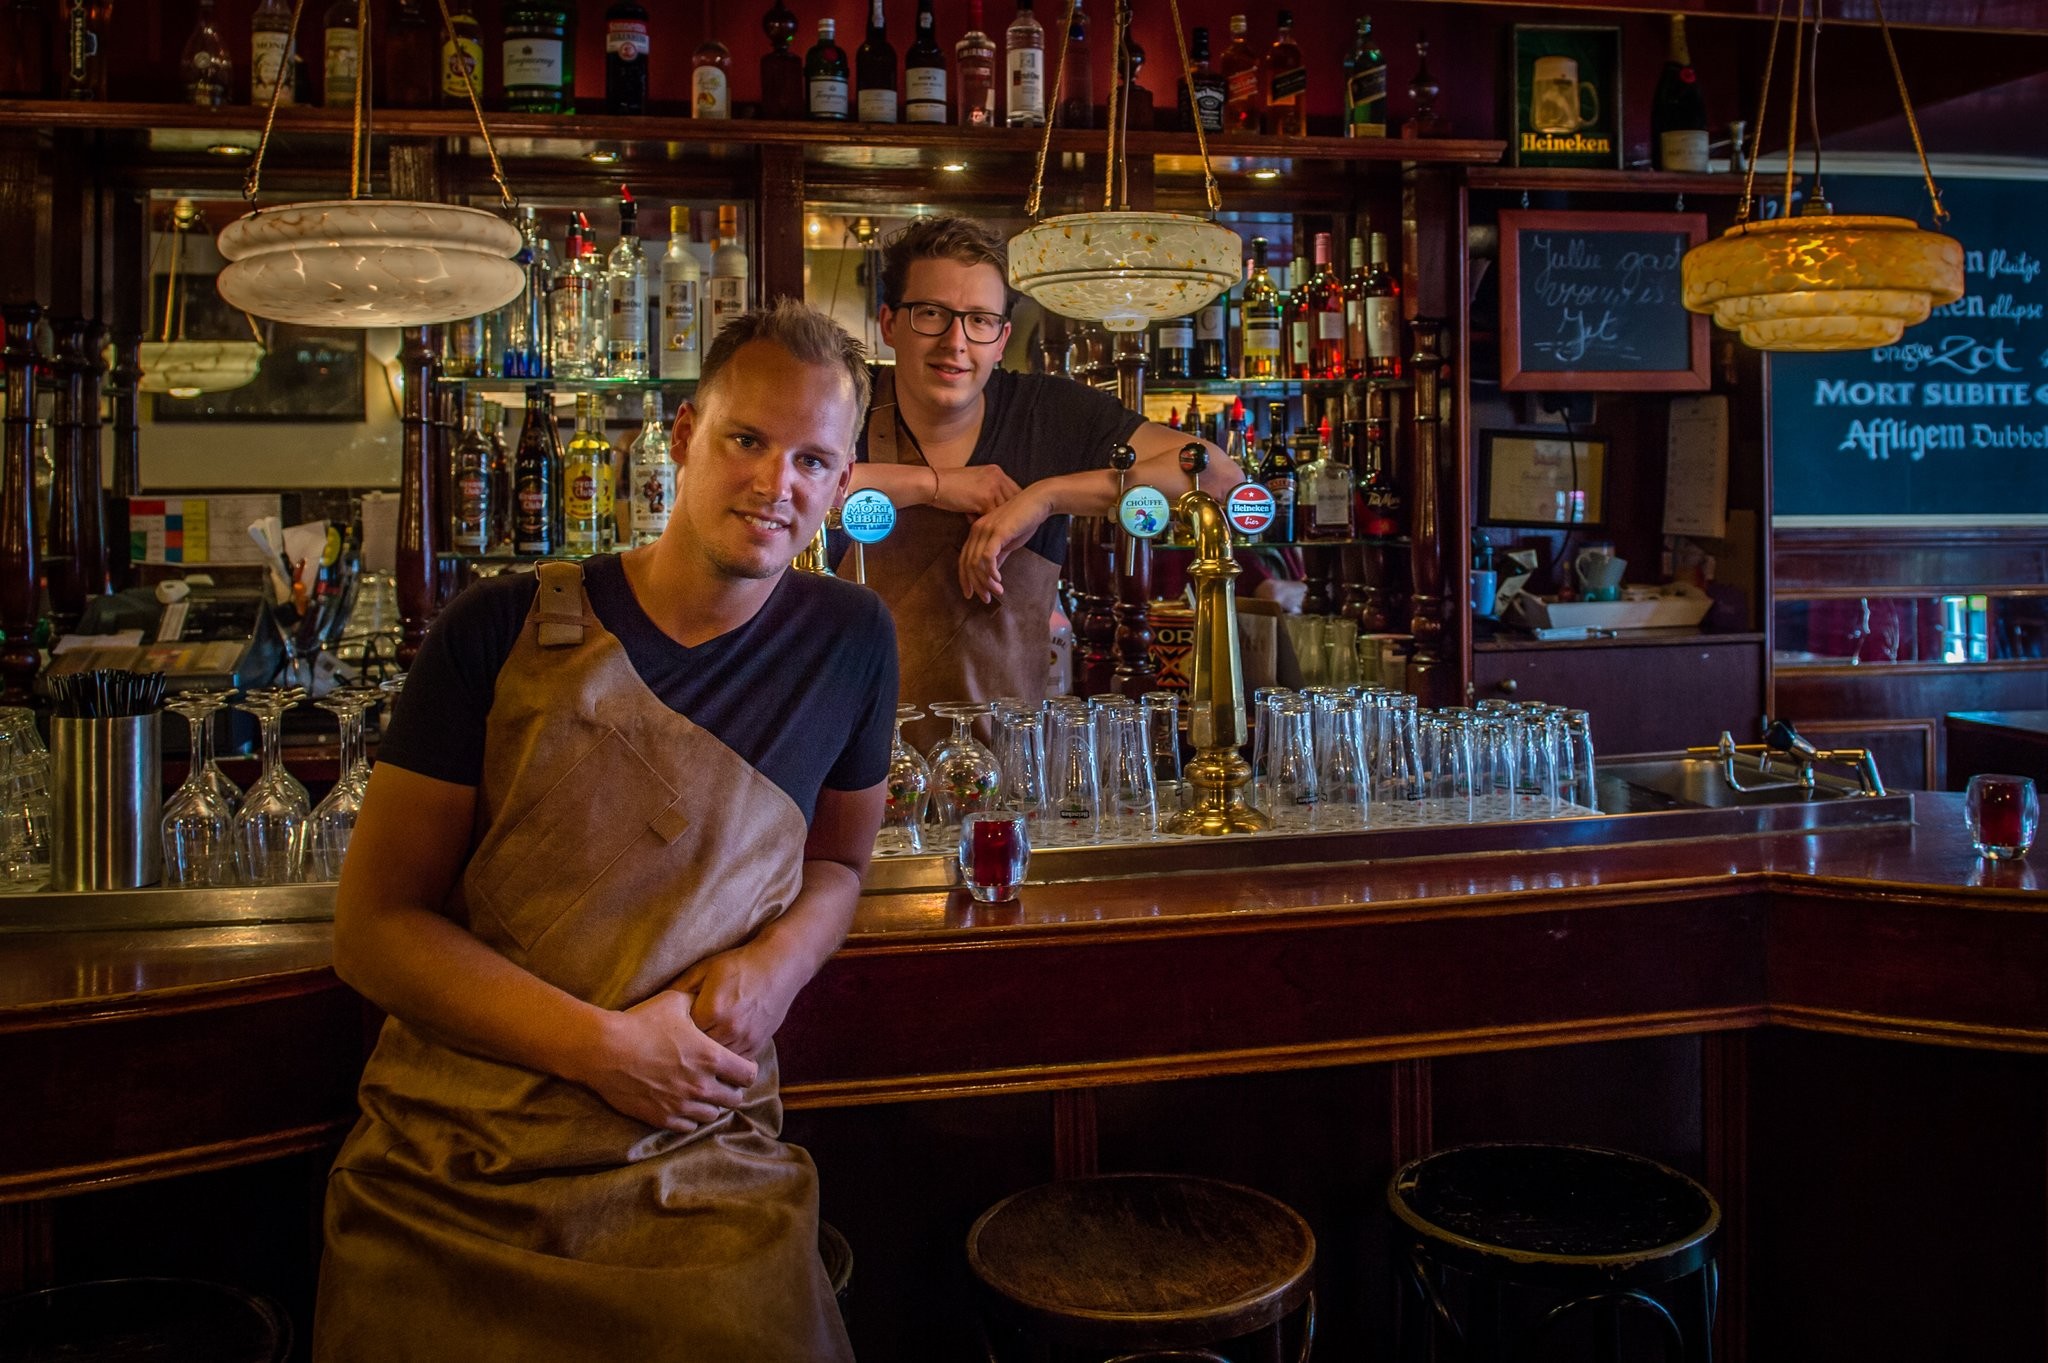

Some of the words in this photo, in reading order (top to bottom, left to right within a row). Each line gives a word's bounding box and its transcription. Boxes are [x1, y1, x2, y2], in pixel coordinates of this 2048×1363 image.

[1521, 132, 1610, 153] Heineken
[1988, 293, 2044, 325] ellipse
[1927, 335, 2024, 375] Zot
[1814, 379, 1915, 407] MORT
[1921, 382, 2031, 407] SUBITE
[1838, 417, 1967, 462] Affligem
[847, 503, 890, 514] MORT
[1126, 499, 1163, 507] CHOUFFE
[1233, 504, 1270, 512] Heineken
[845, 513, 892, 524] SUBITE
